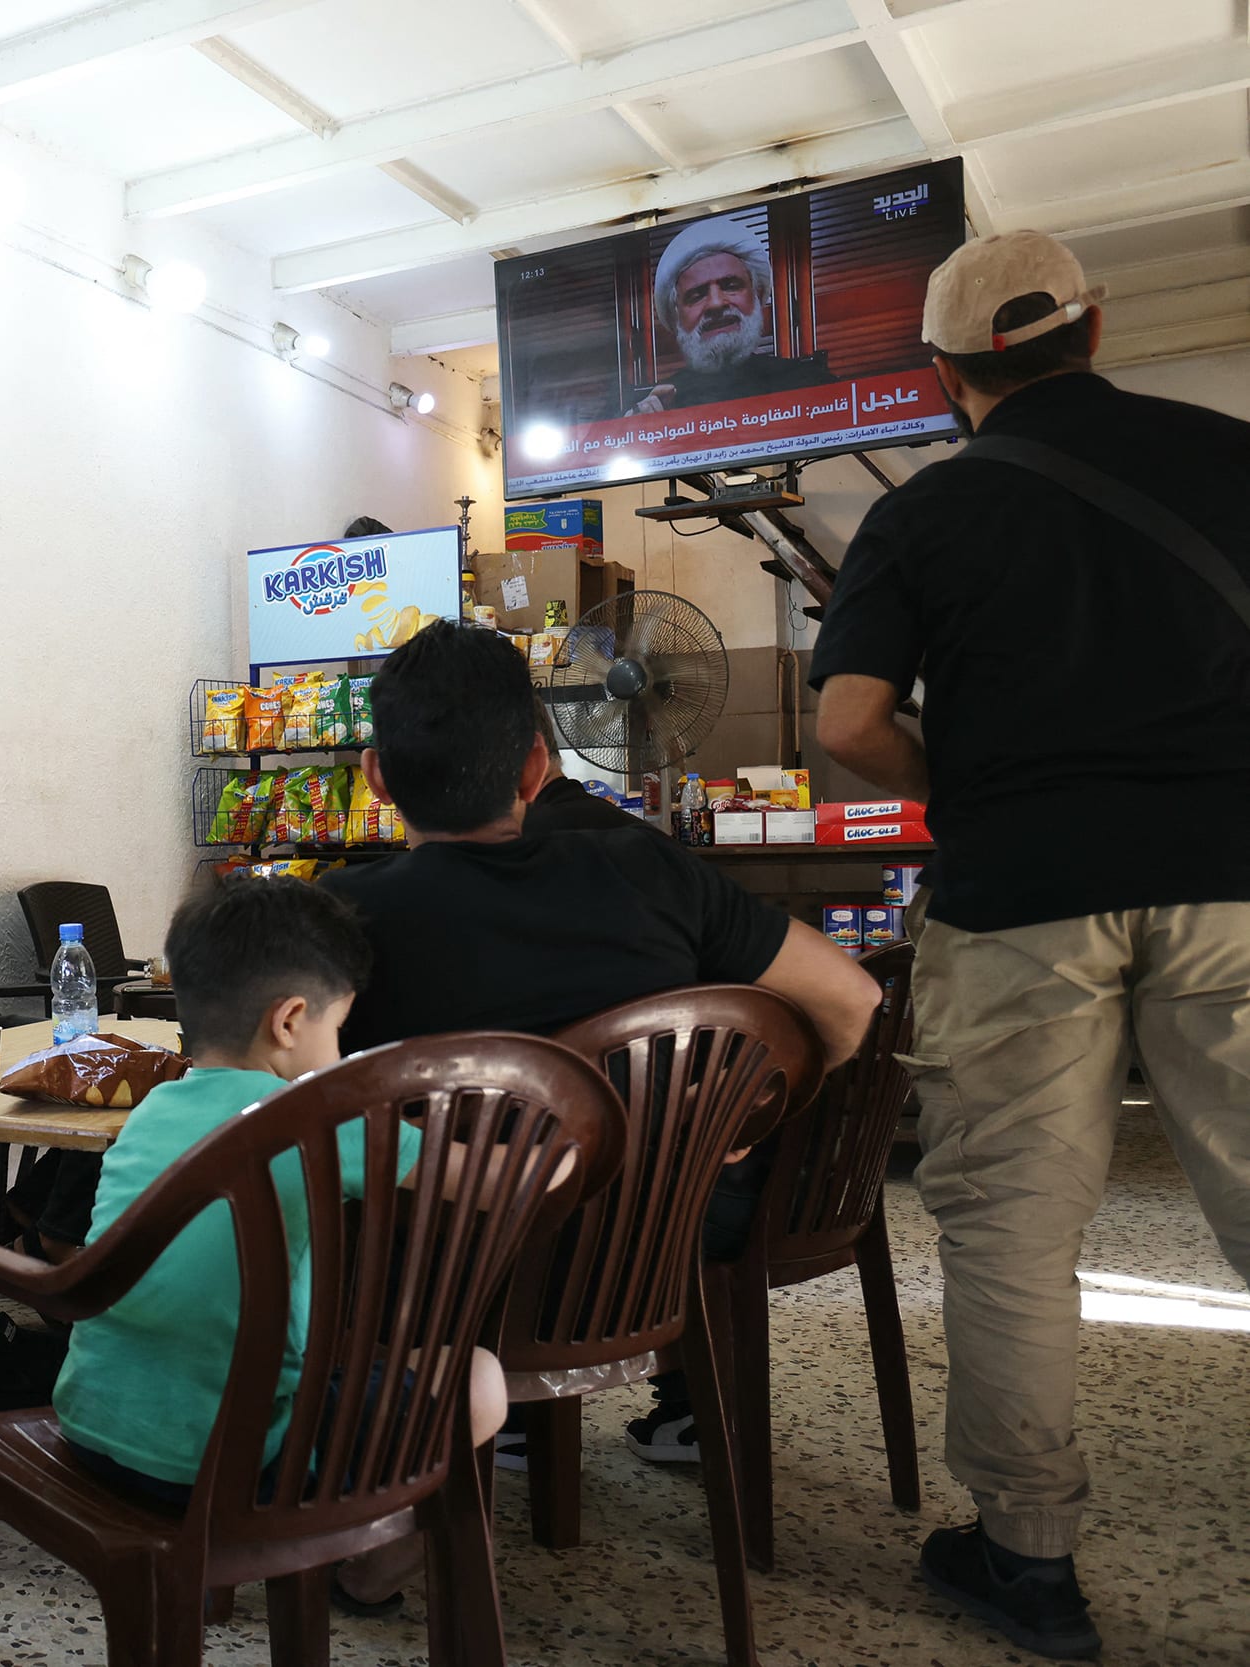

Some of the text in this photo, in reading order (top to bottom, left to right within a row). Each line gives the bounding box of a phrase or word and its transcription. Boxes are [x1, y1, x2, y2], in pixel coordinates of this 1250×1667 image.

[873, 183, 928, 213] الجديد
[885, 206, 917, 221] LIVE
[520, 267, 545, 280] 12:13
[861, 387, 919, 413] عاجل
[805, 397, 848, 419] قاسم:
[741, 405, 801, 427] المقاومة
[699, 416, 738, 435] جاهزة
[901, 420, 925, 430] وكالة
[604, 431, 634, 449] البرية
[638, 422, 695, 444] للمواجهة
[821, 434, 843, 445] رئيس
[583, 441, 600, 454] مع
[766, 440, 794, 453] الشيخ
[795, 437, 819, 447] الدولة
[739, 446, 764, 455] محمد
[264, 548, 387, 602] KARKISH
[846, 804, 899, 818] CHOC-OLE
[846, 826, 898, 839] CHOC-OLE
